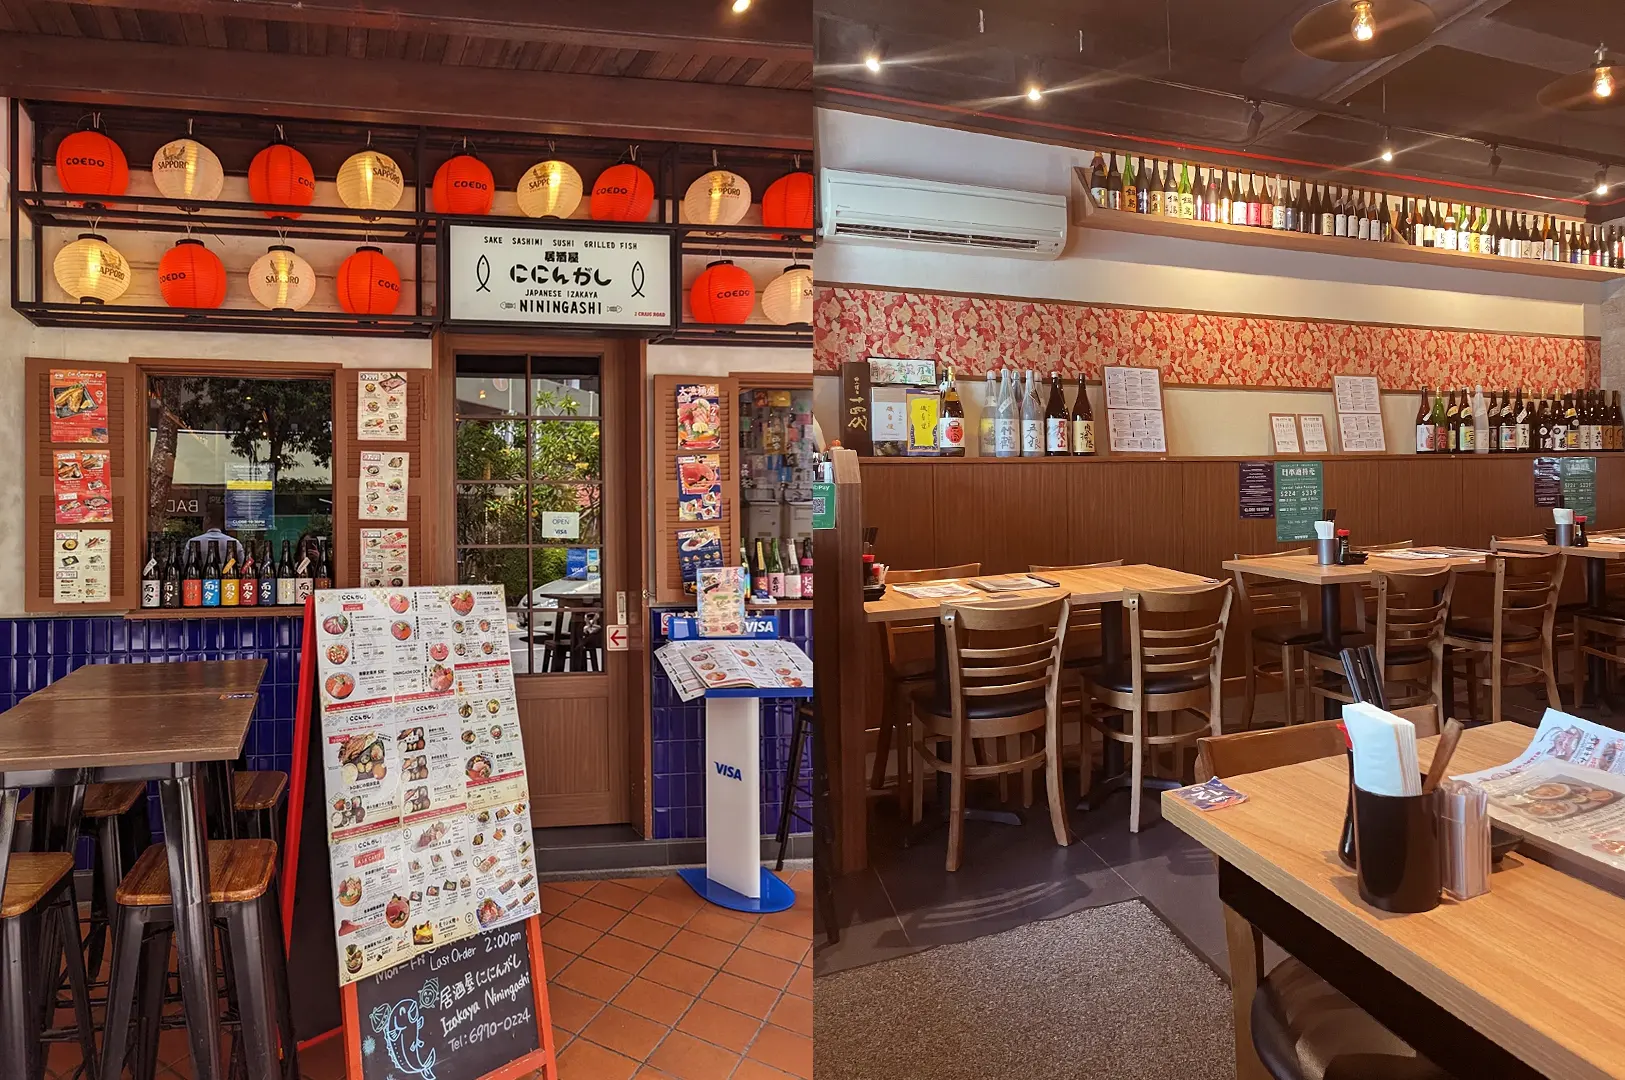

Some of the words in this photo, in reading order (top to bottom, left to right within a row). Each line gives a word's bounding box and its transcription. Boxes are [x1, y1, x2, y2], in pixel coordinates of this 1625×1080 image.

[66, 158, 105, 168] COEDO
[453, 181, 488, 191] COEDO
[596, 187, 628, 196] COEDO
[484, 236, 503, 245] SAKE
[512, 237, 543, 247] SASHIMI
[553, 239, 576, 249] SUSHI
[584, 241, 616, 250] GRILLED
[620, 242, 638, 251] FISH
[544, 251, 579, 263] 居酒屋
[96, 265, 125, 281] APPORO
[509, 263, 612, 287] ににんがし
[524, 289, 563, 298] JAPANESE
[567, 290, 599, 299] IZAKAYA
[716, 290, 750, 299] COEDO
[519, 299, 602, 315] NININGASHI
[639, 311, 652, 319] CRAIG
[745, 620, 775, 633] VISA
[713, 761, 742, 781] VISA
[430, 956, 450, 972] Last
[450, 945, 476, 963] Order
[484, 931, 522, 954] 2:00pm
[440, 1001, 481, 1038] Izakaya
[484, 971, 531, 1010] Niningashi
